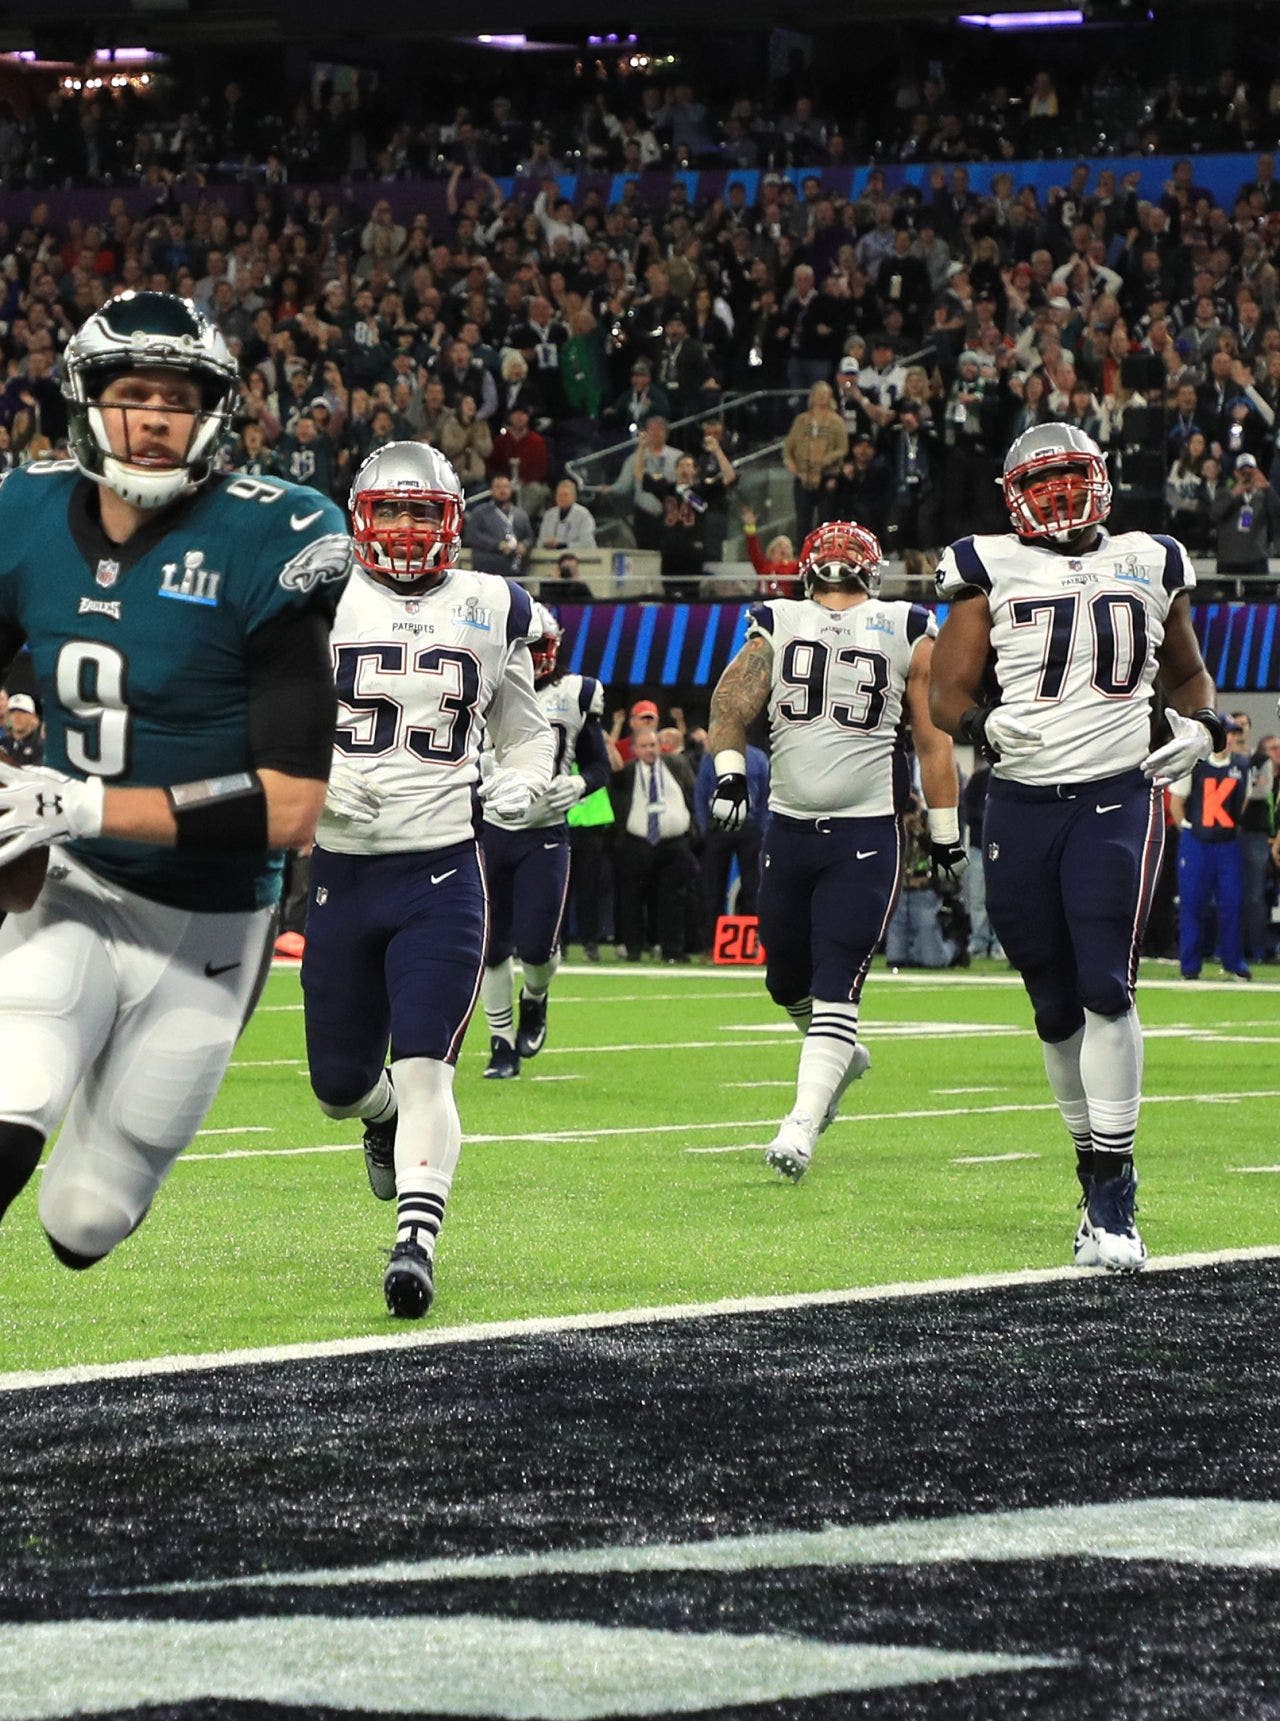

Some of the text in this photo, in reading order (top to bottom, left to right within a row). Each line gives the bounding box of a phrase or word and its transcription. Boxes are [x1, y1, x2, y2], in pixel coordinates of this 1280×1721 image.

[78, 597, 121, 620] EAGLES
[392, 622, 434, 634] PATRIOTS
[1008, 591, 1149, 703] 70
[56, 640, 129, 776] 9
[332, 642, 482, 767] 53
[777, 636, 891, 735] 93
[1202, 777, 1238, 828] K
[719, 924, 758, 959] 20
